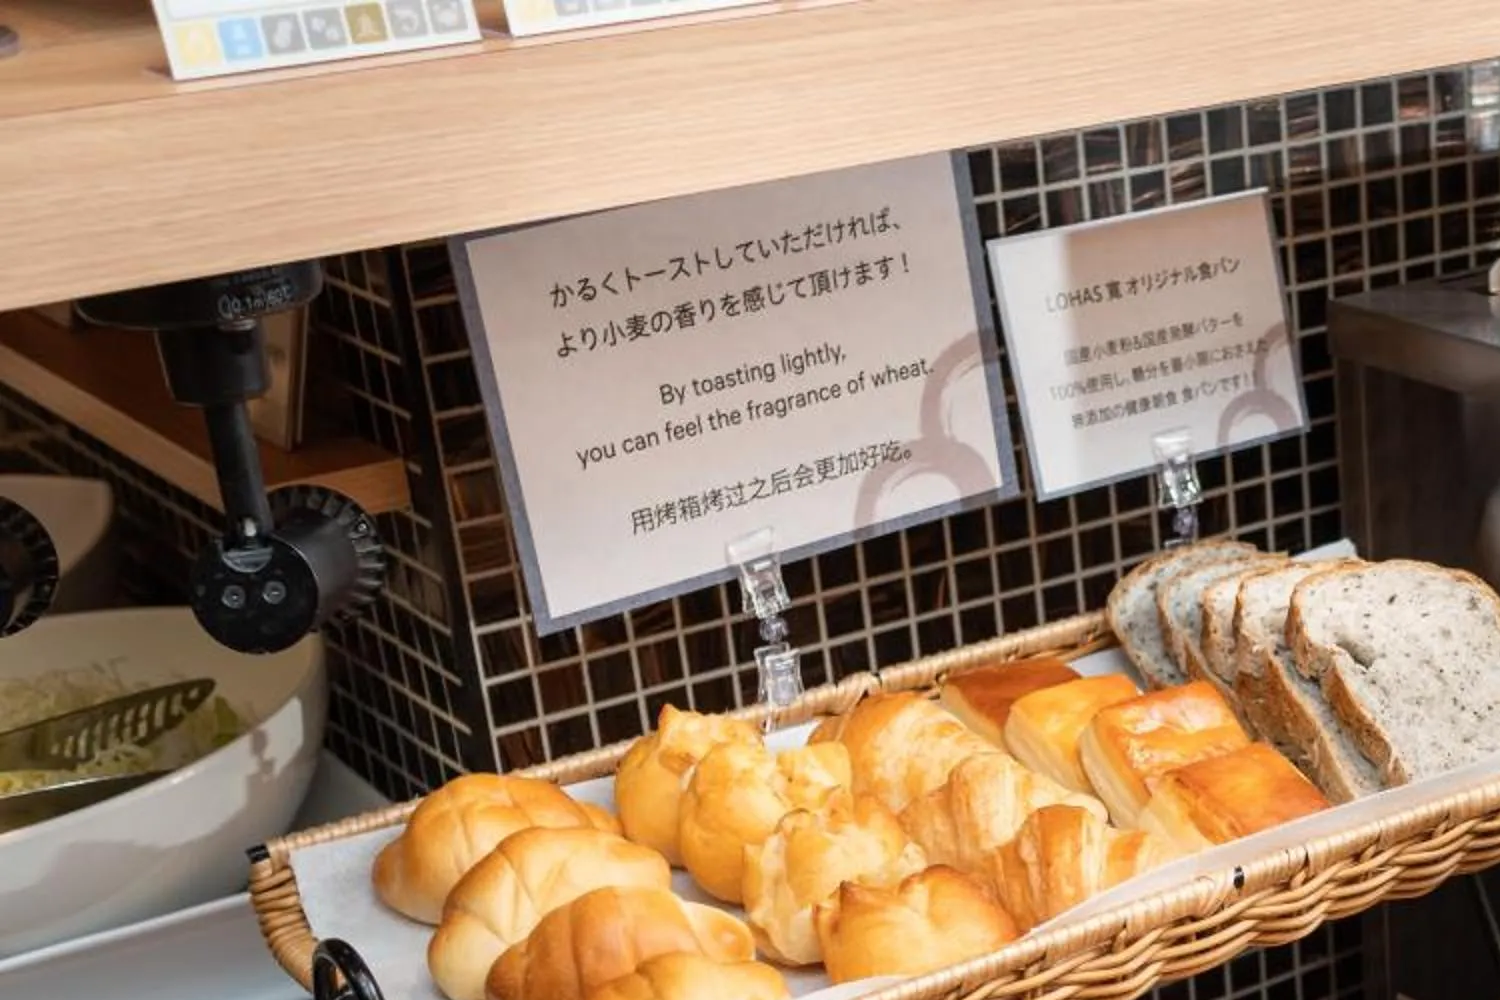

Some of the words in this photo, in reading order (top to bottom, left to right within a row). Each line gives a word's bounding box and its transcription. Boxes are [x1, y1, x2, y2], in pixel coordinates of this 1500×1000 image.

[550, 206, 901, 309] かるくトーストしていただければ、
[1045, 285, 1103, 313] LOHAS
[576, 442, 617, 472] you
[621, 432, 661, 455] can
[664, 416, 704, 444] feel
[706, 408, 743, 431] the
[746, 384, 842, 421] fragrance
[846, 371, 867, 396] of
[871, 359, 935, 388] wheat.
[659, 383, 688, 407] By
[691, 361, 777, 398] toasting
[779, 343, 847, 378] lightly,
